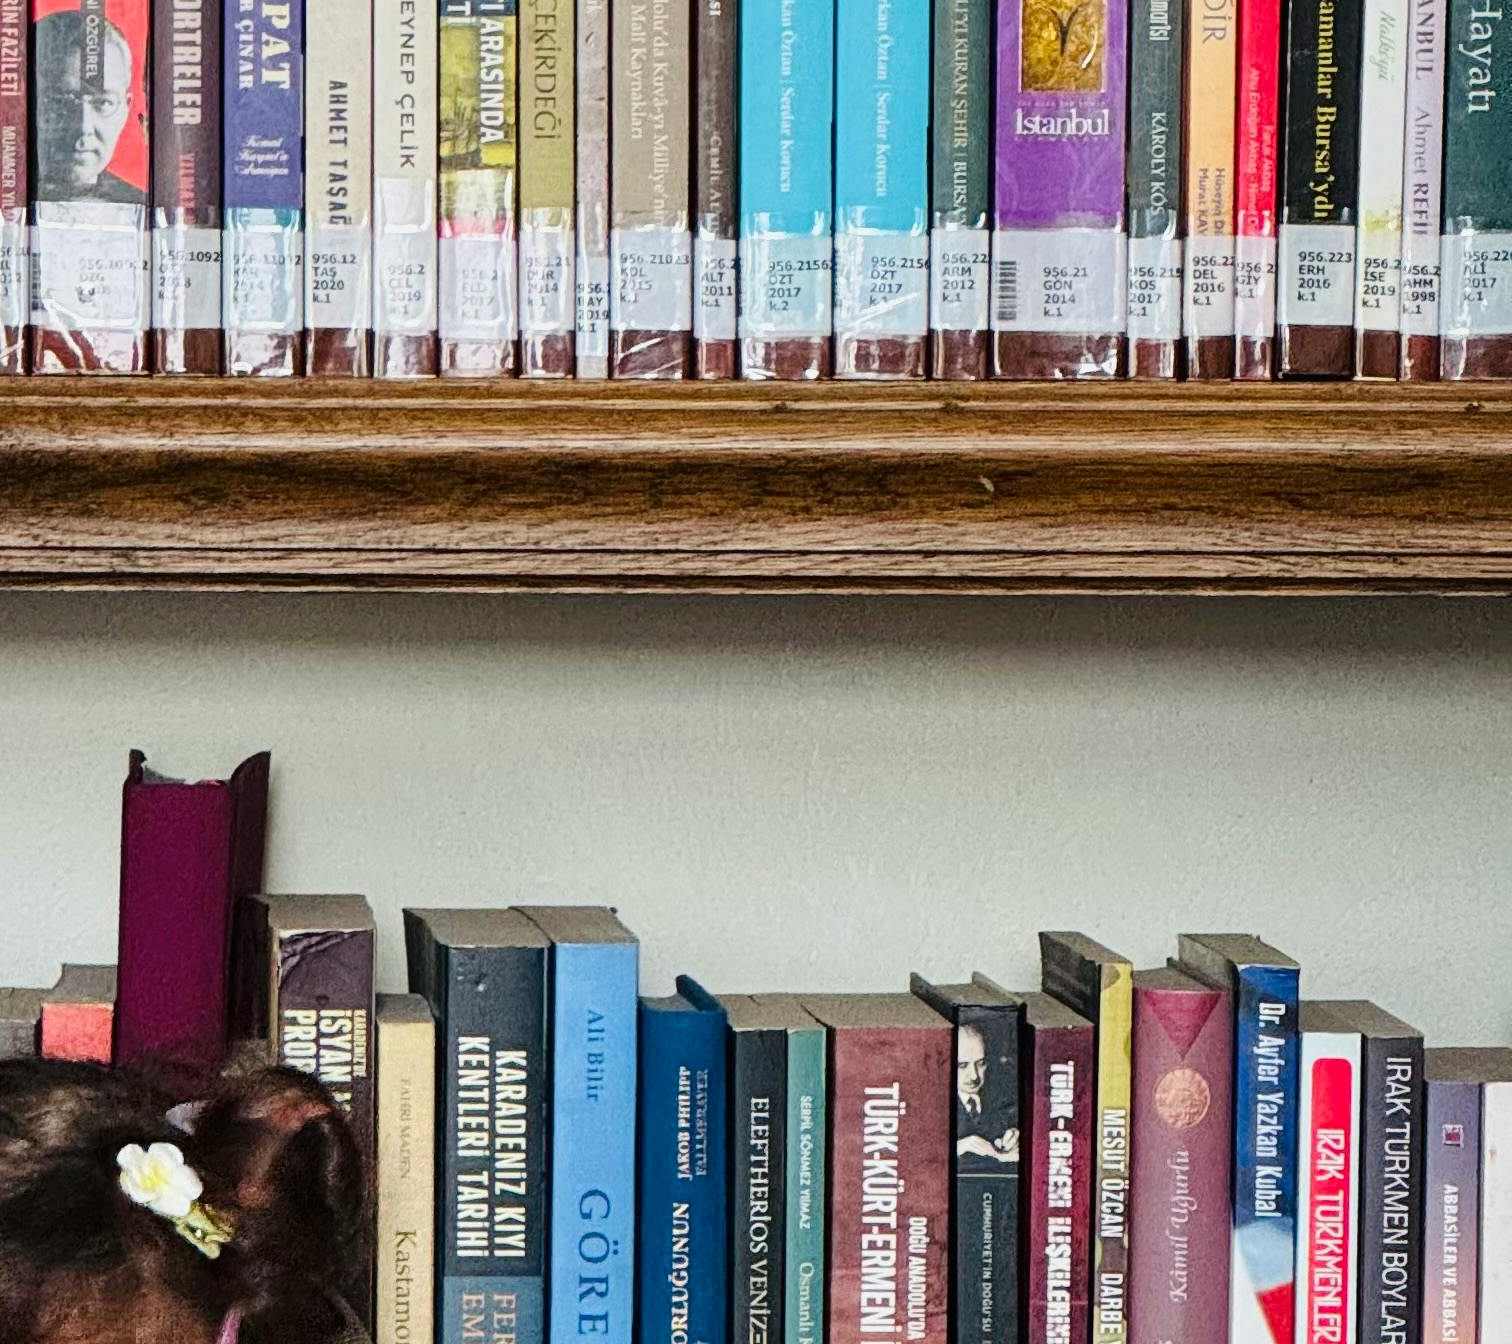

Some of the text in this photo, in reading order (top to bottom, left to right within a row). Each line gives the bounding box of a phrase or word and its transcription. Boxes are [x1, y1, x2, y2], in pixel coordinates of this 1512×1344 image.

[329, 80, 349, 147] AHMET
[478, 18, 505, 144] ARASINDA
[395, 94, 418, 168] ÇELİK
[1309, 106, 1338, 219] Bursa'ydı
[1298, 251, 1352, 262] 956.223
[1298, 264, 1326, 275] ERH
[1298, 278, 1330, 289] 2016
[1384, 1057, 1411, 1117] IRAK
[457, 1036, 493, 1257] KENTLERİ TARİHİ
[494, 1050, 531, 1257] KARADENİZ KIYI
[1101, 1109, 1126, 1171] MESUT
[1253, 1035, 1286, 1218] Ayfer Yazkan Kubal
[857, 1083, 903, 1335] TÜRK-KÜRT-ERMENİ
[1101, 1179, 1130, 1237] ÖZCAN
[1382, 1123, 1413, 1246] TÜRKMEN
[798, 1262, 815, 1333] Osmanlı
[1099, 1274, 1125, 1334] DARBE
